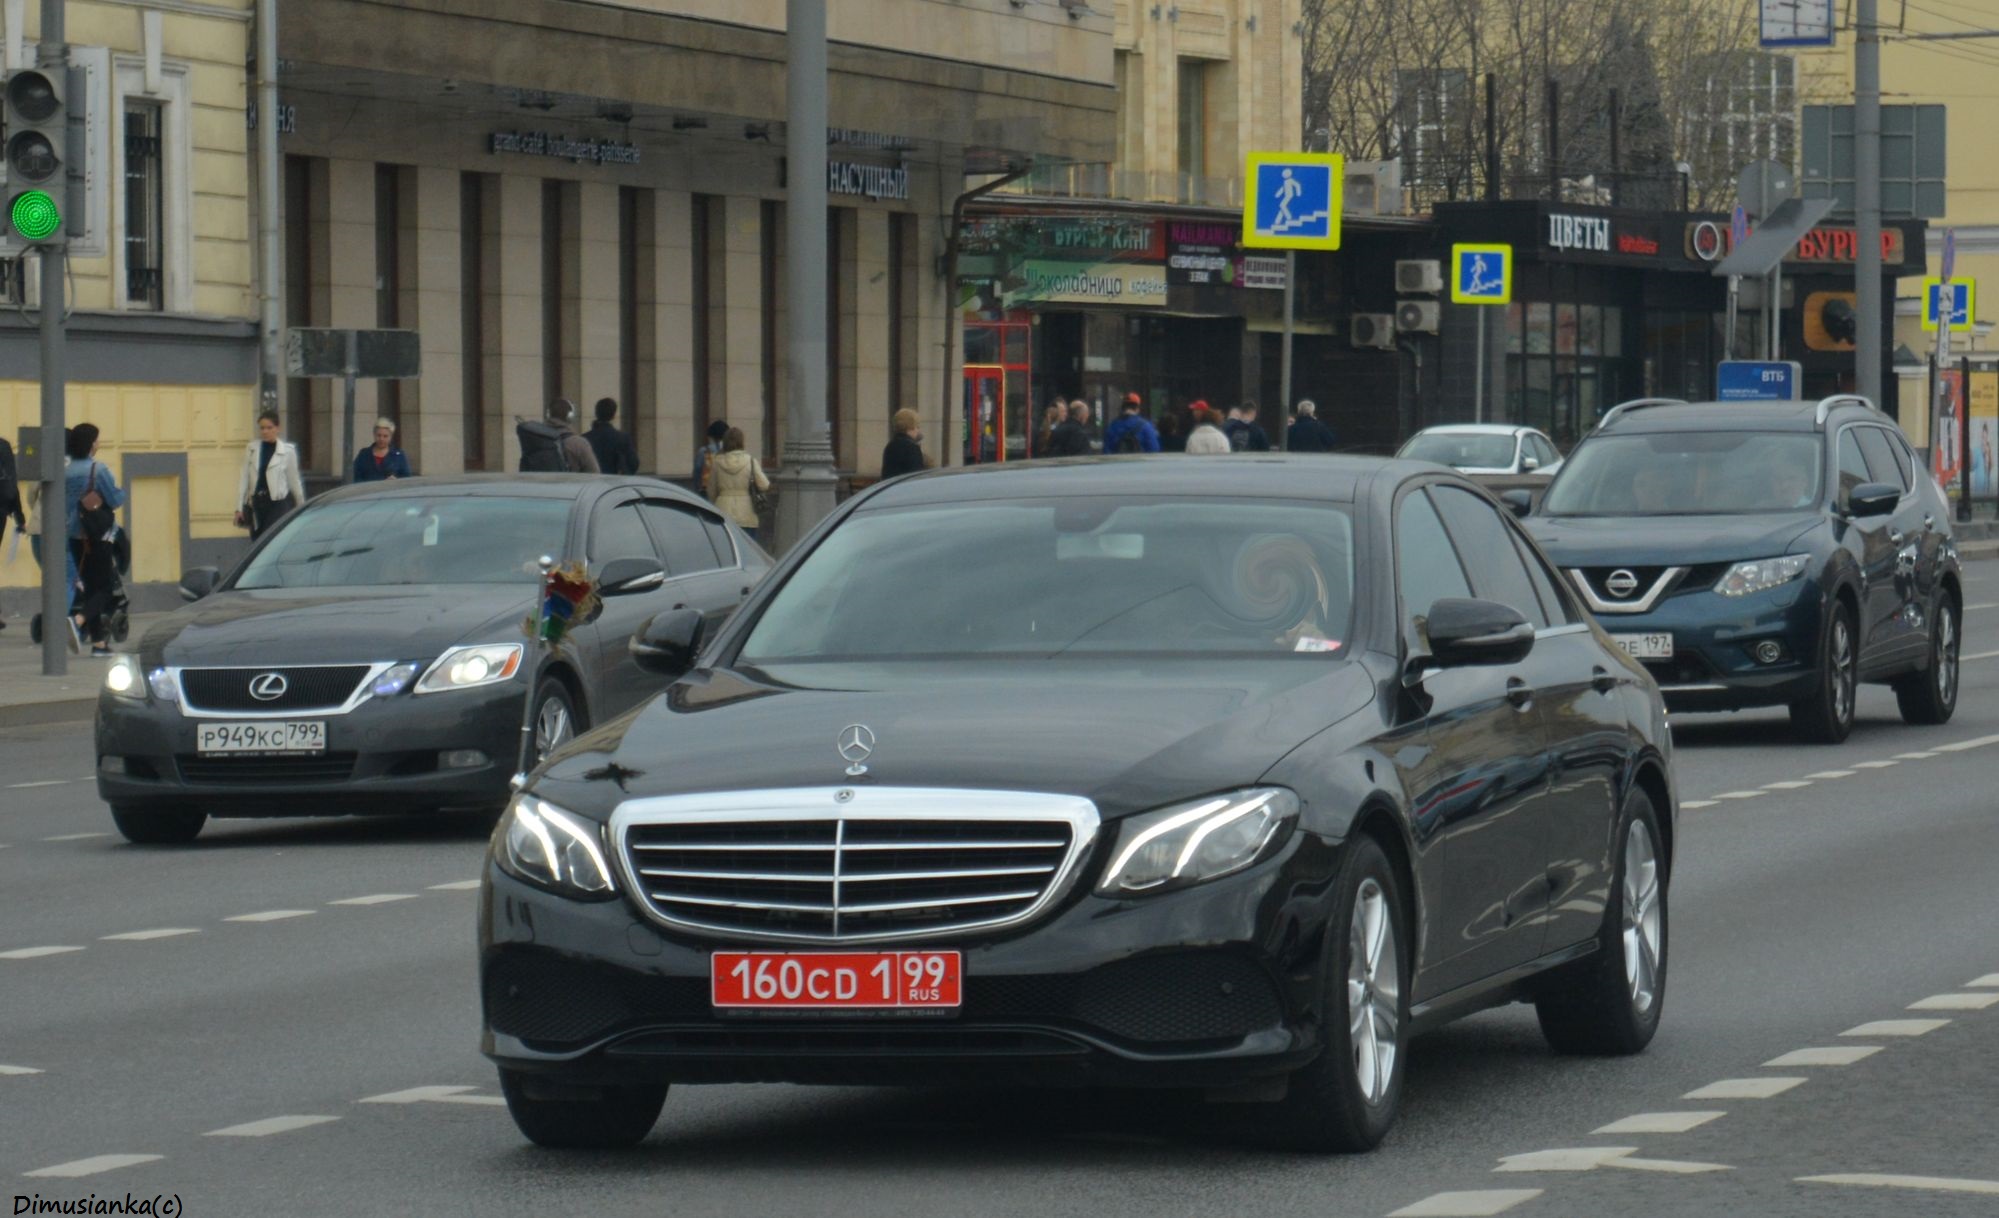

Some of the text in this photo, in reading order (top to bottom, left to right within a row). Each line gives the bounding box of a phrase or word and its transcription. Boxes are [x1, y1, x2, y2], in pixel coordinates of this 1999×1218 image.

[829, 160, 909, 201] НАСУЩНЫЙ
[1548, 213, 1610, 253] ЦВЕТЫ
[1799, 228, 1896, 261] БУРГР
[1026, 267, 1123, 297] Шоколадница
[1761, 369, 1785, 383] ВТБ
[1644, 635, 1668, 651] 197
[287, 723, 320, 740] 799
[903, 956, 945, 988] 99
[908, 988, 940, 1001] RUS
